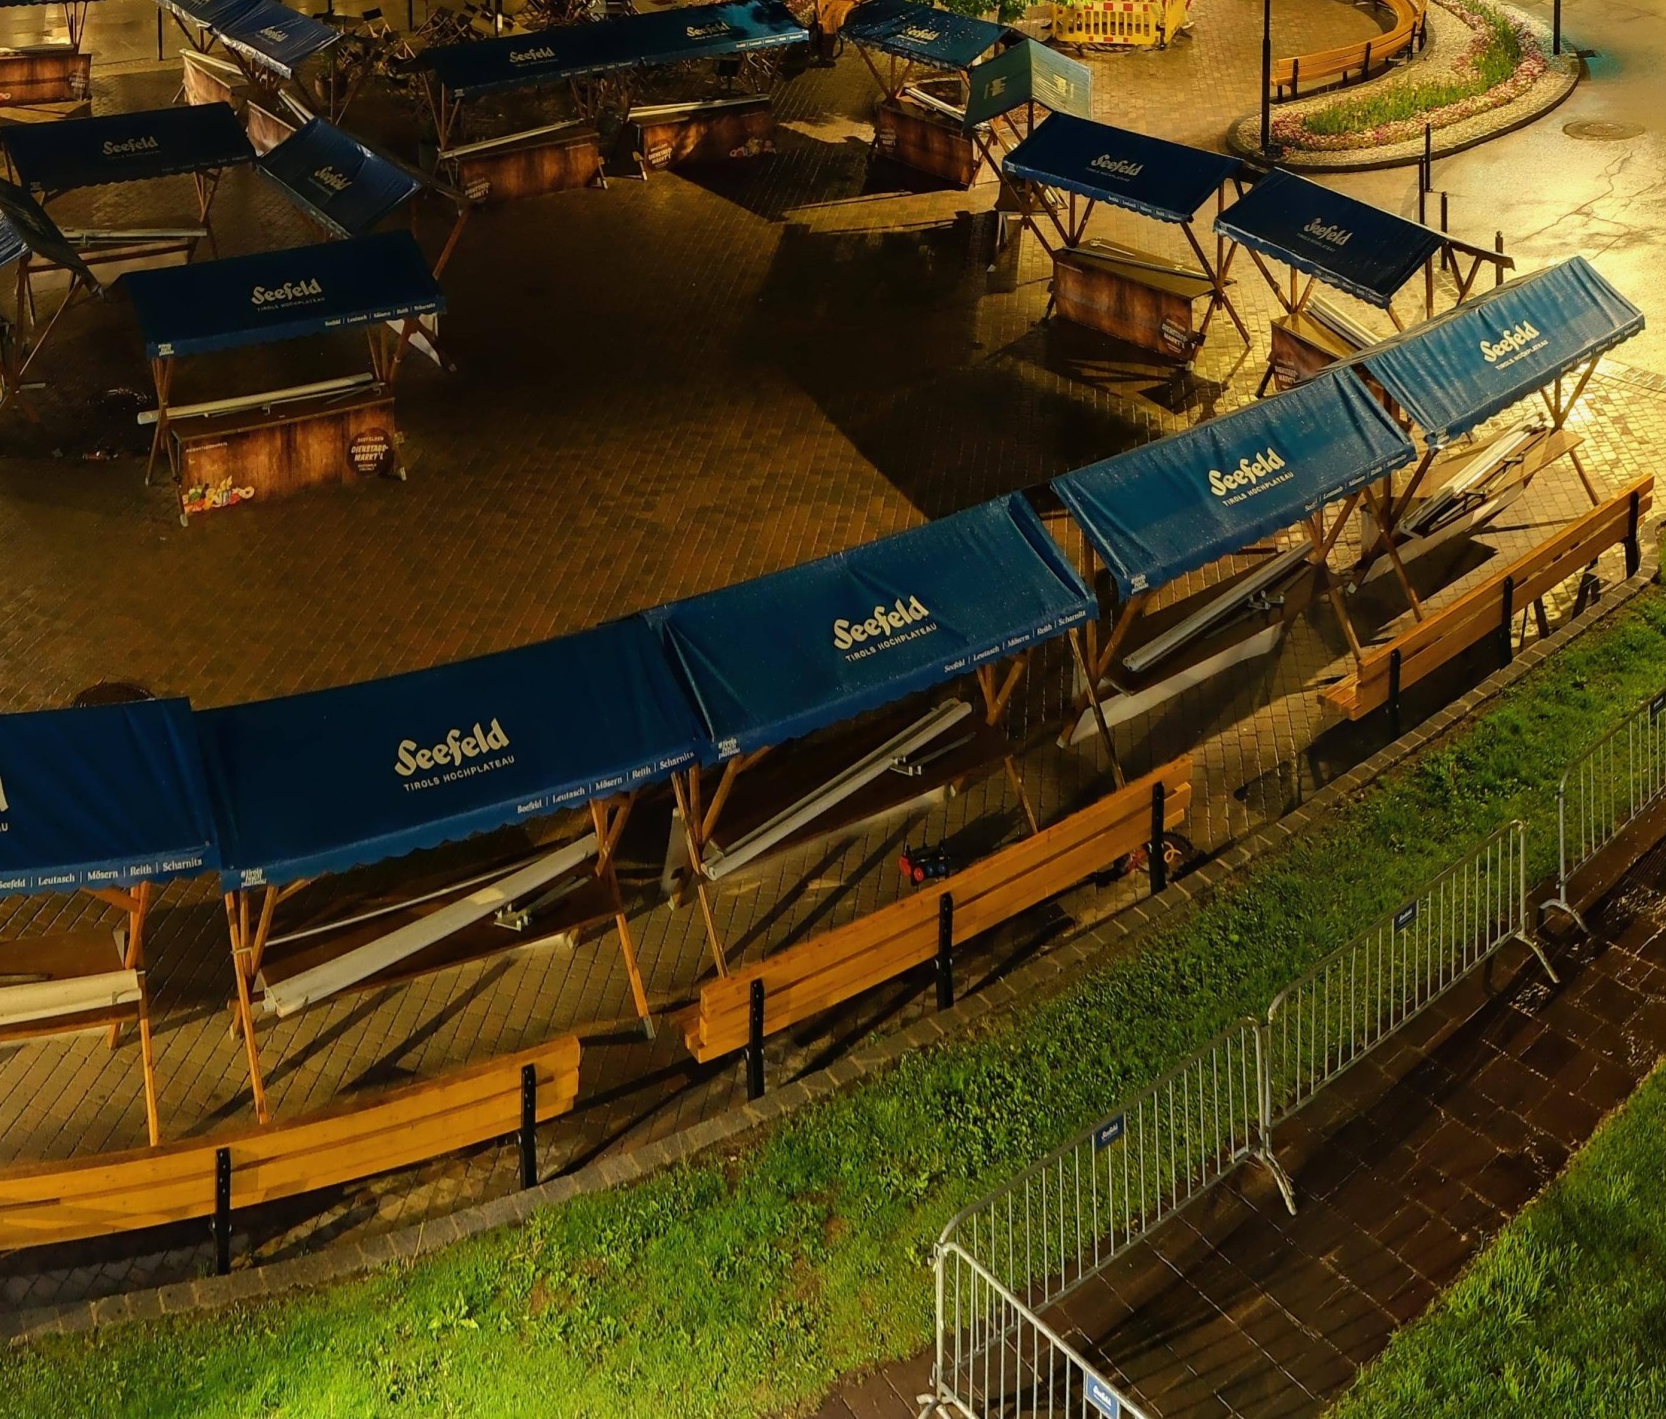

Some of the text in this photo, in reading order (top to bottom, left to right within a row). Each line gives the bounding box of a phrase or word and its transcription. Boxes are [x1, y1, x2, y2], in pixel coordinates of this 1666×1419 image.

[687, 21, 731, 38] Seefeld
[509, 46, 555, 63] Seefeld
[102, 136, 159, 156] Seefeld
[1091, 154, 1144, 176] Seefeld
[1304, 217, 1353, 246] Seefeld
[251, 278, 323, 305] Seefeld
[1480, 320, 1541, 363] Seefeld
[1208, 447, 1286, 497] Seefeld
[1222, 471, 1294, 507] TIROLS HOCHPLATEAU
[834, 595, 930, 650] Seefeld
[845, 623, 937, 663] TIROLS HOCHPLATEAU
[394, 718, 510, 776] Seefeld
[403, 755, 515, 792] TIROLS HOCHPLATEAU
[553, 786, 585, 804] Leutasch
[595, 775, 623, 791] Mösern
[632, 766, 651, 780] Reith
[660, 751, 695, 770] Scharnitz
[38, 872, 75, 886] Leutasch
[87, 868, 118, 880] Mösern
[130, 864, 152, 876] Reith
[162, 856, 202, 872] Scharnitz
